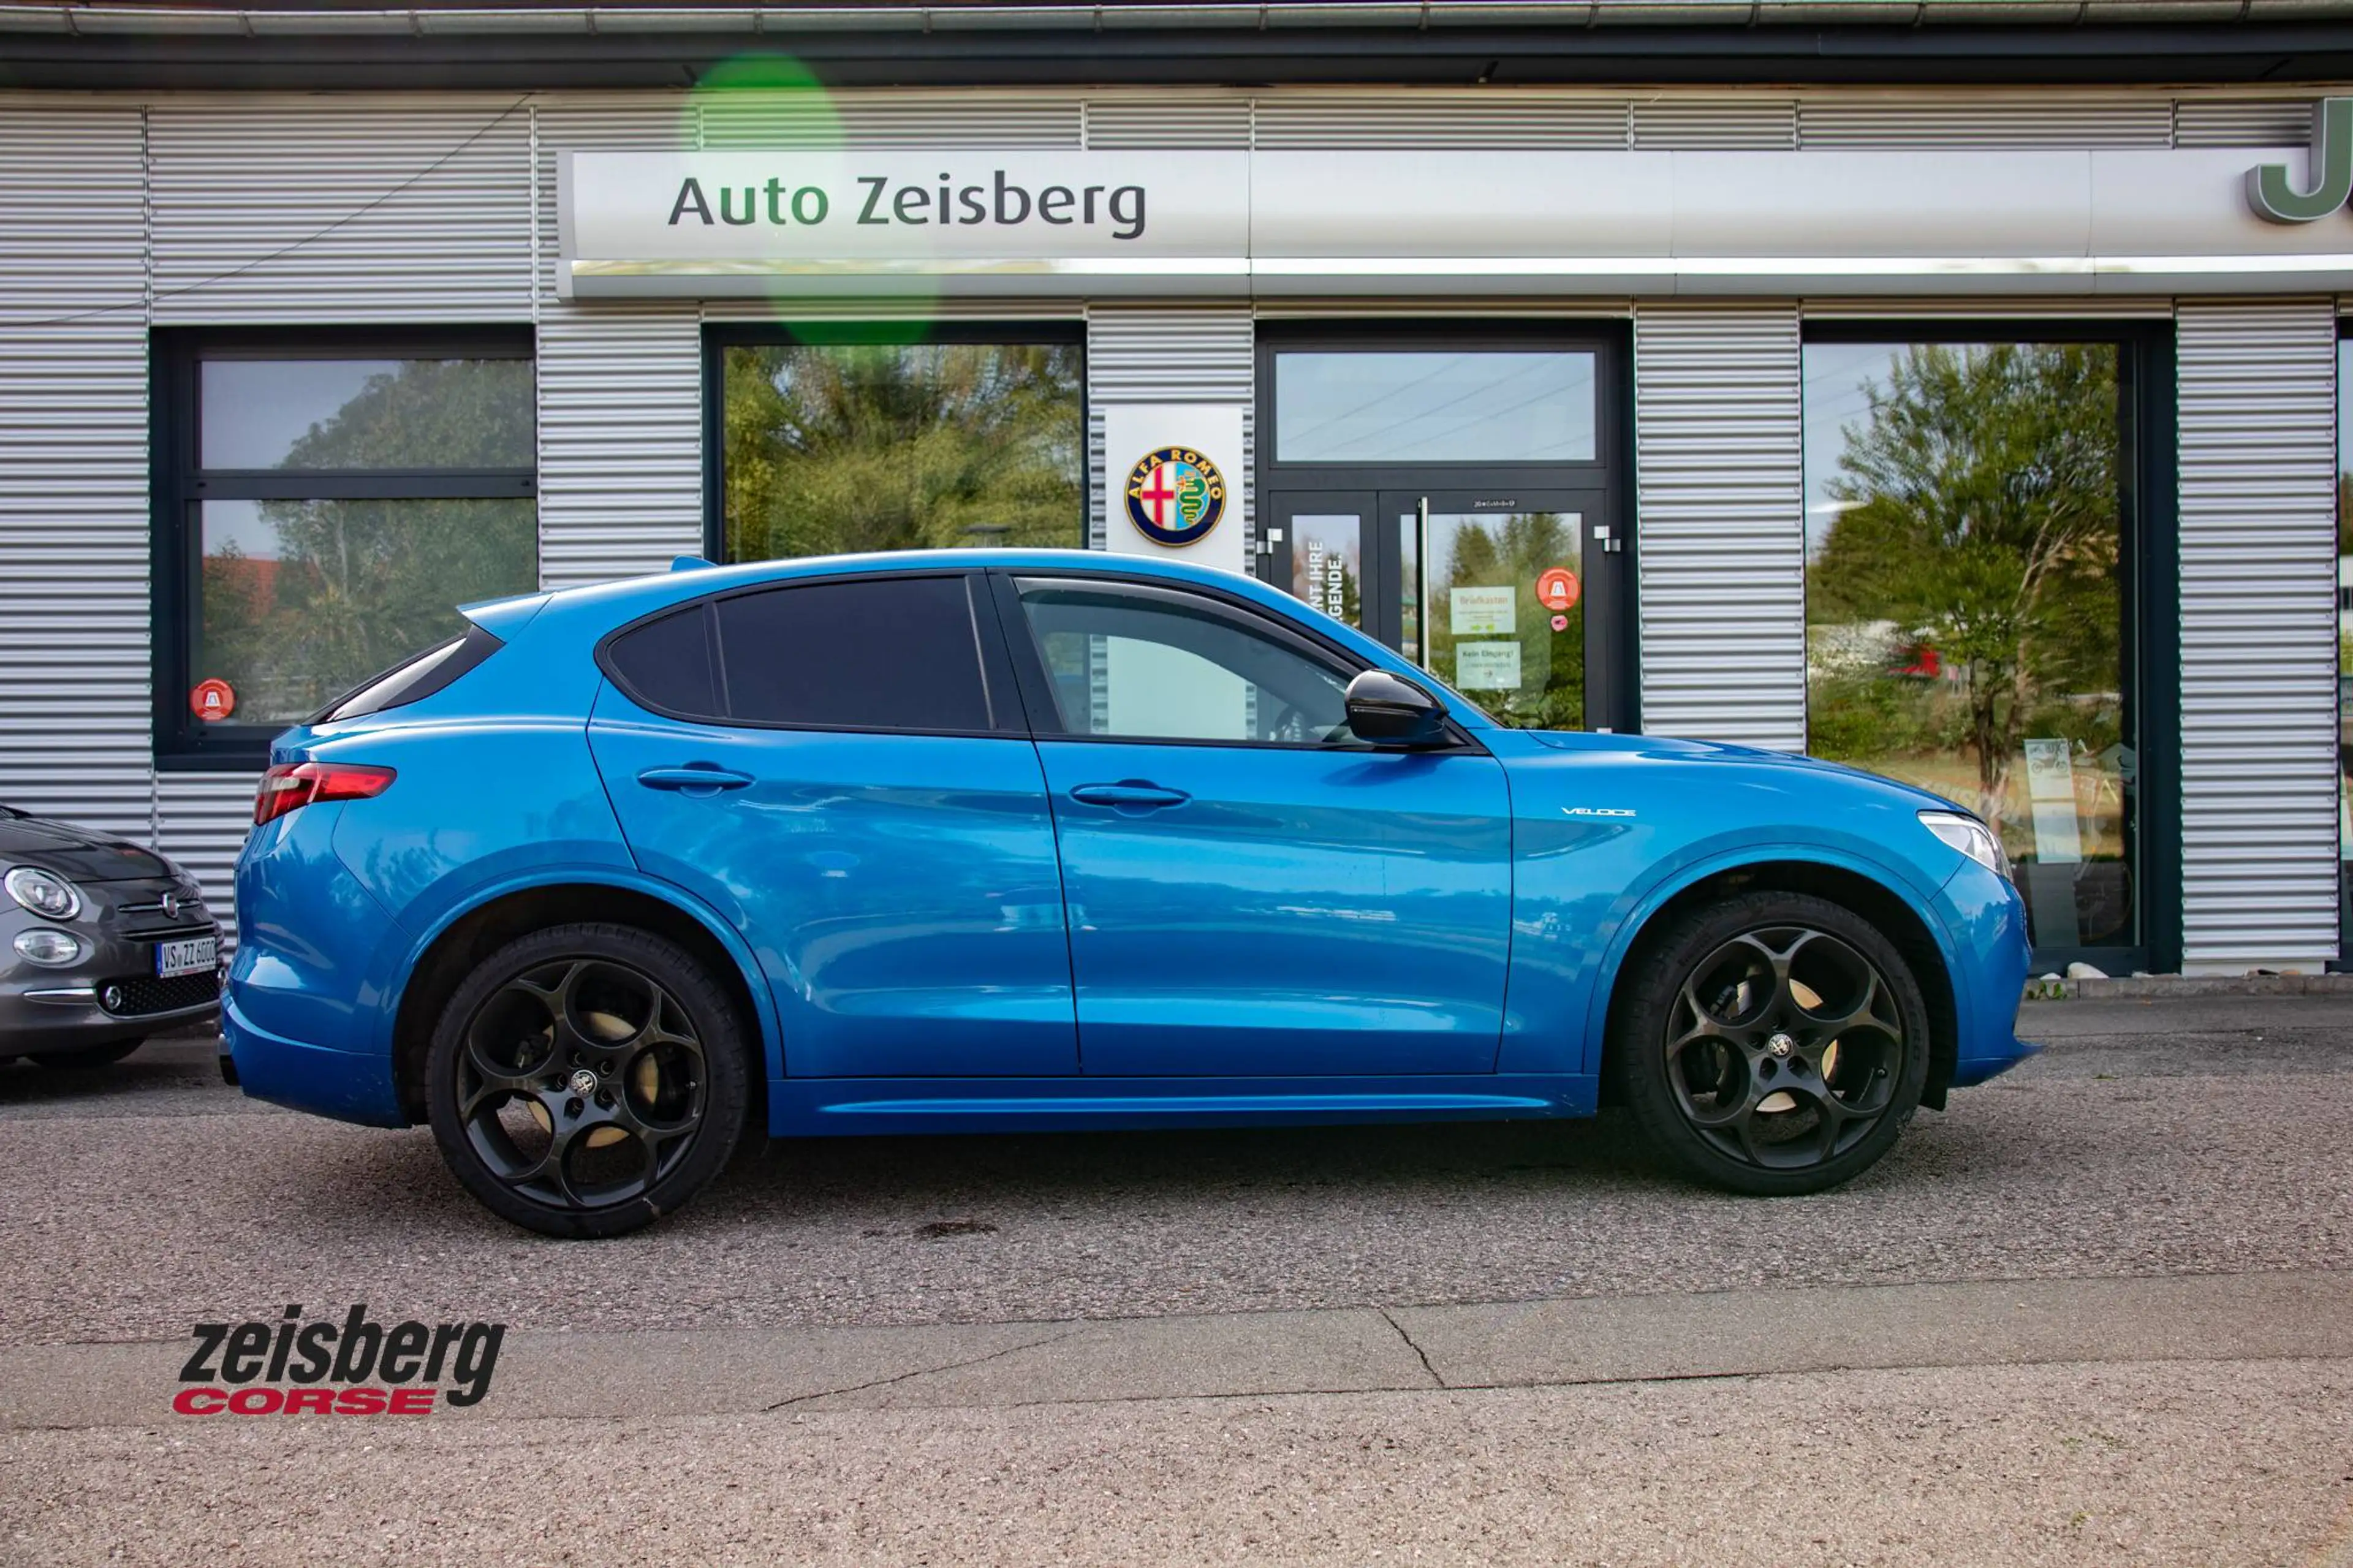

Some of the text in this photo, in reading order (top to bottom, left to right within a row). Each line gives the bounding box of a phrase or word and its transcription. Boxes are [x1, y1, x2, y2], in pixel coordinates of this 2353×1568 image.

[2248, 96, 2353, 225] J
[668, 170, 1145, 240] Auto Zeisberg
[1128, 449, 1222, 500] ALFA ROMEO
[1309, 542, 1324, 610] NT IHRE
[1561, 806, 1637, 817] VELOCE
[164, 945, 176, 968] VS
[184, 944, 194, 966] ZZ
